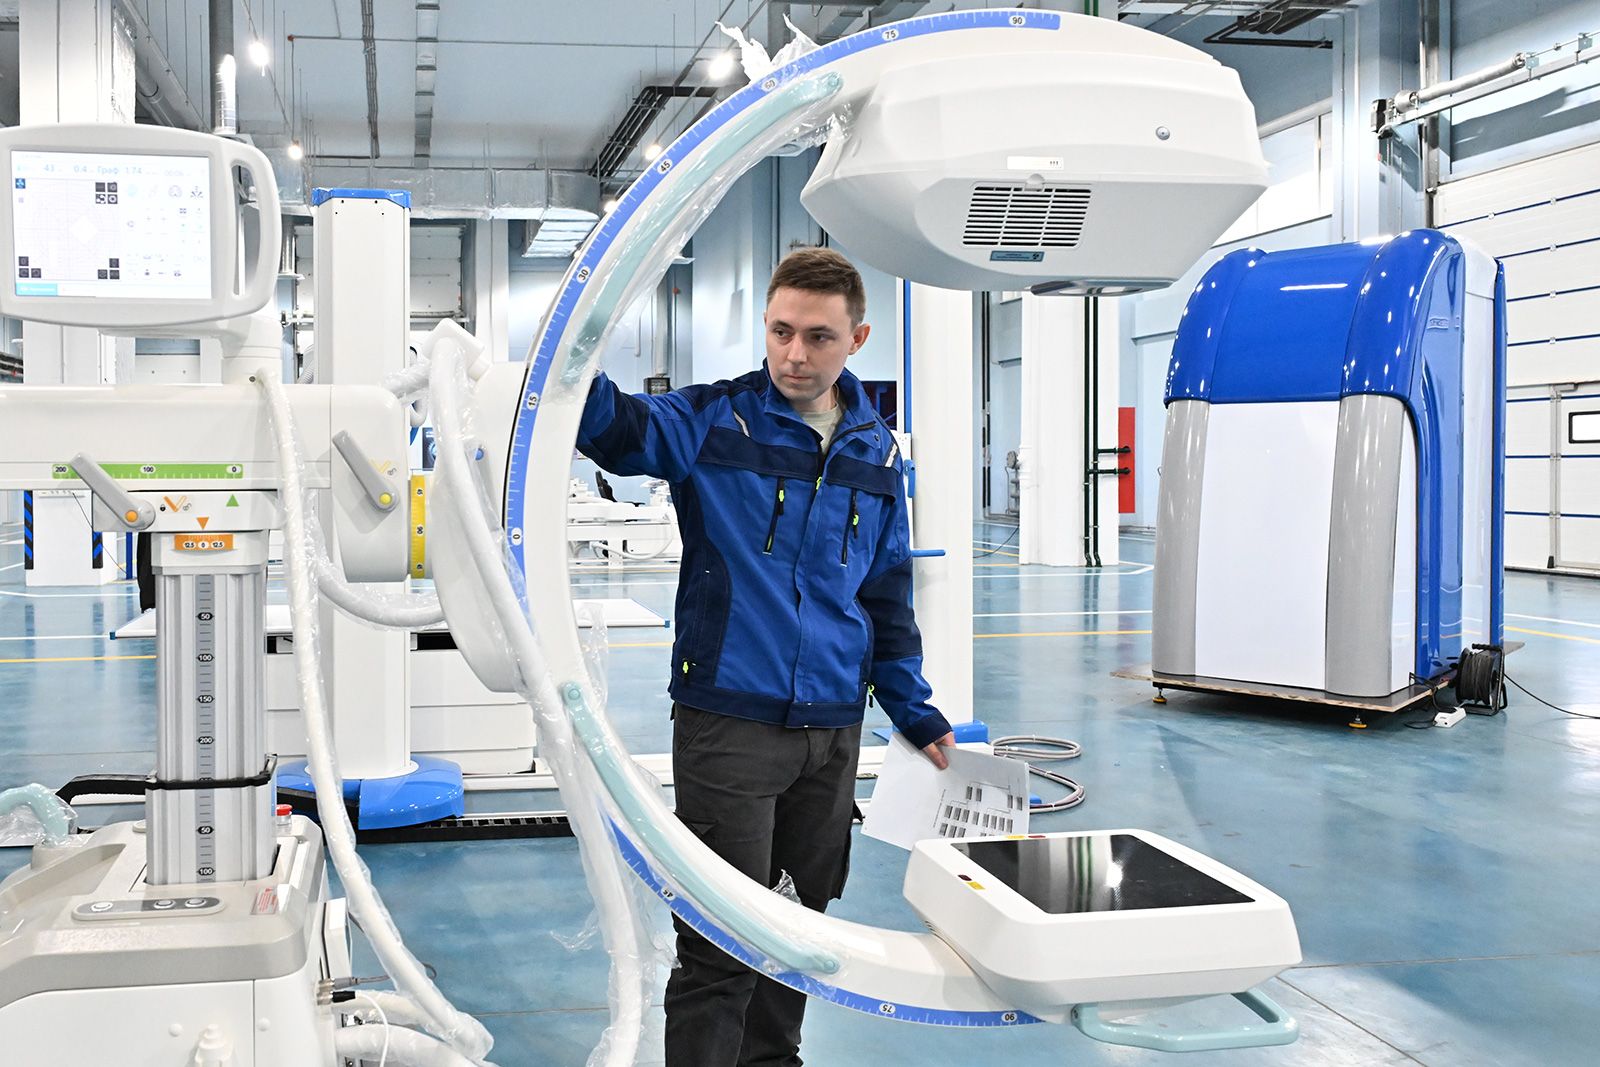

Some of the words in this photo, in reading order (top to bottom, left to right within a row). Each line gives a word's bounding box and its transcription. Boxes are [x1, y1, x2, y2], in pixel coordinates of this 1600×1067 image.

[1012, 16, 1023, 25] 90
[885, 30, 897, 39] 75
[660, 160, 671, 172] 45
[578, 269, 589, 281] 30
[528, 395, 537, 407] 15
[882, 1004, 893, 1013] 75
[1004, 1012, 1015, 1021] 90
